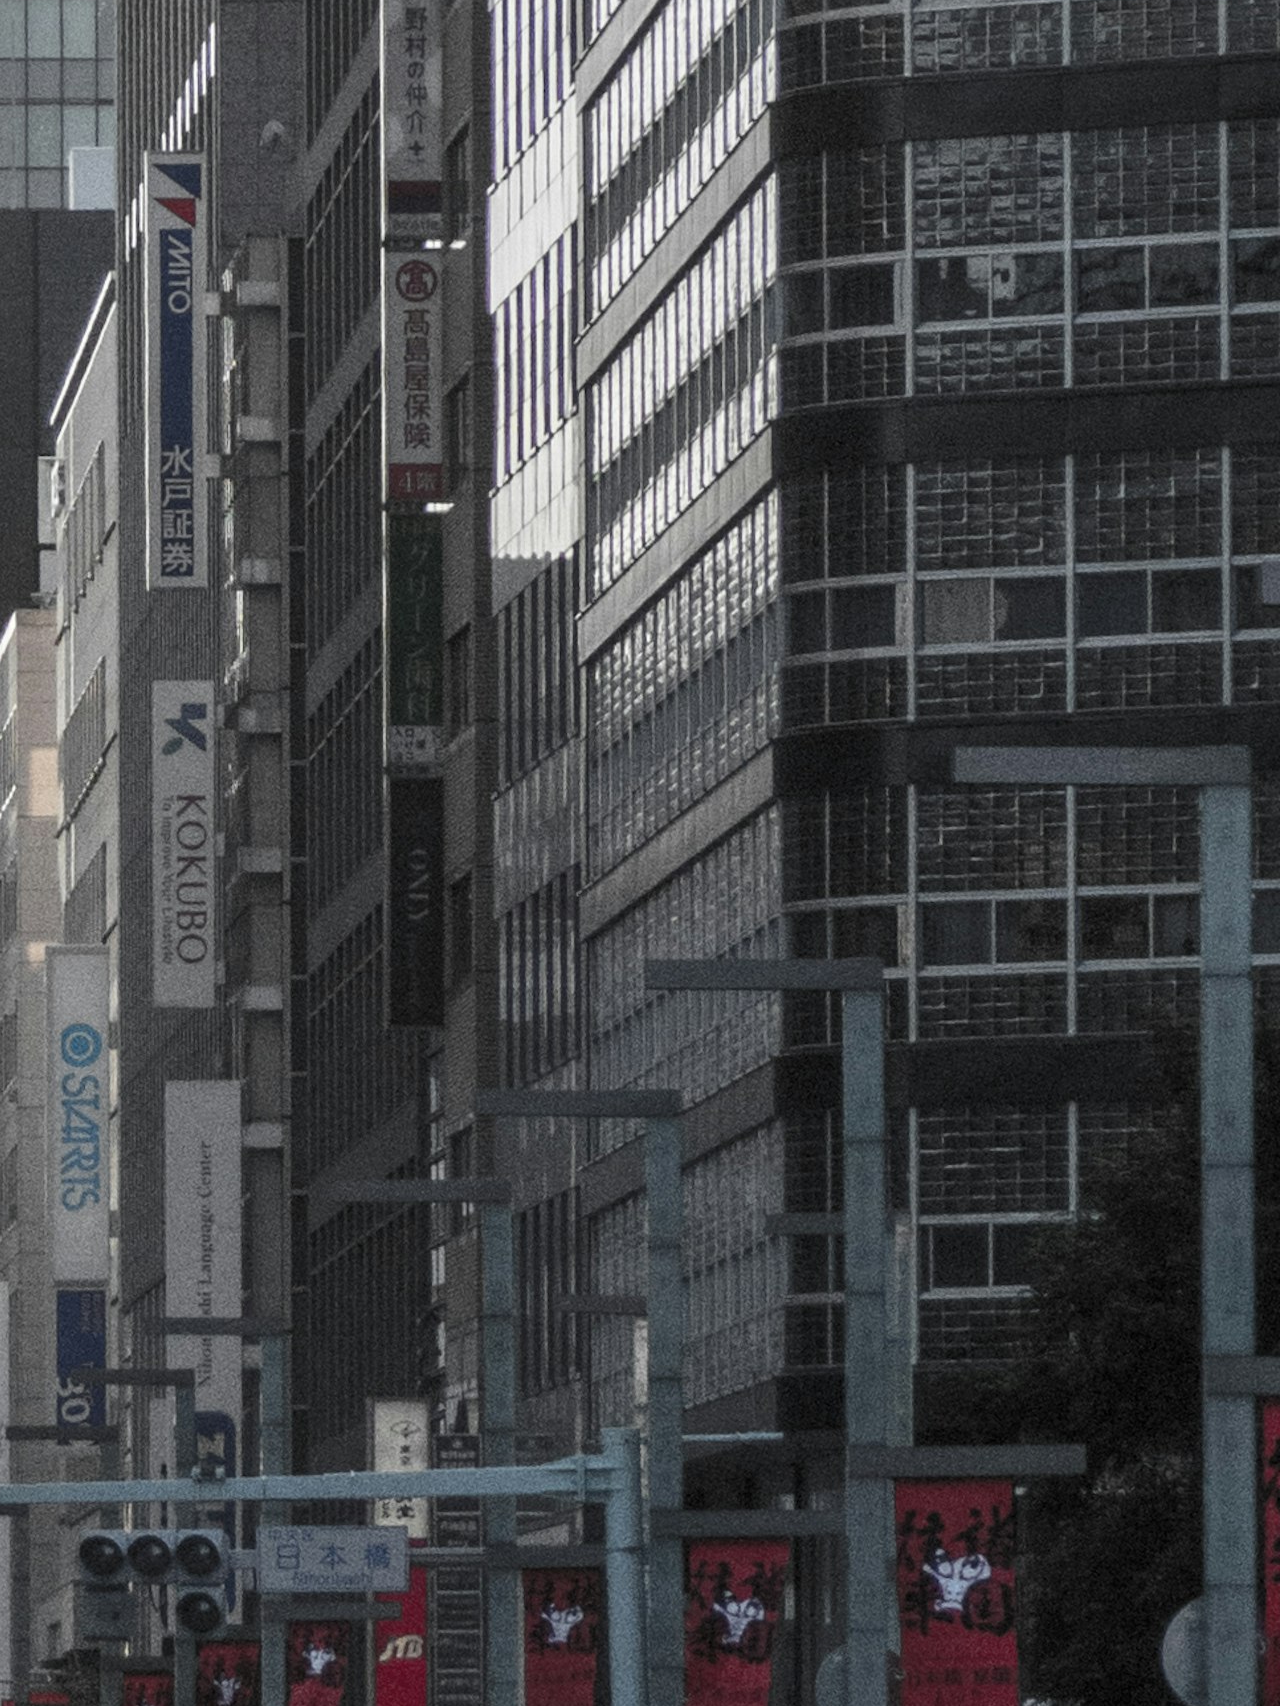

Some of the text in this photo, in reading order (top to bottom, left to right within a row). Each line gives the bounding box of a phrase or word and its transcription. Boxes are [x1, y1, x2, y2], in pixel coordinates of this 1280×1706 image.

[166, 234, 192, 315] MITO
[161, 444, 194, 573] 水戸証券
[176, 795, 208, 964] KOKUBO
[60, 1073, 100, 1212] STARTS
[196, 1140, 212, 1199] Center
[196, 1204, 214, 1285] Language
[276, 1543, 391, 1570] 日本橋
[378, 1634, 424, 1663] JTB
